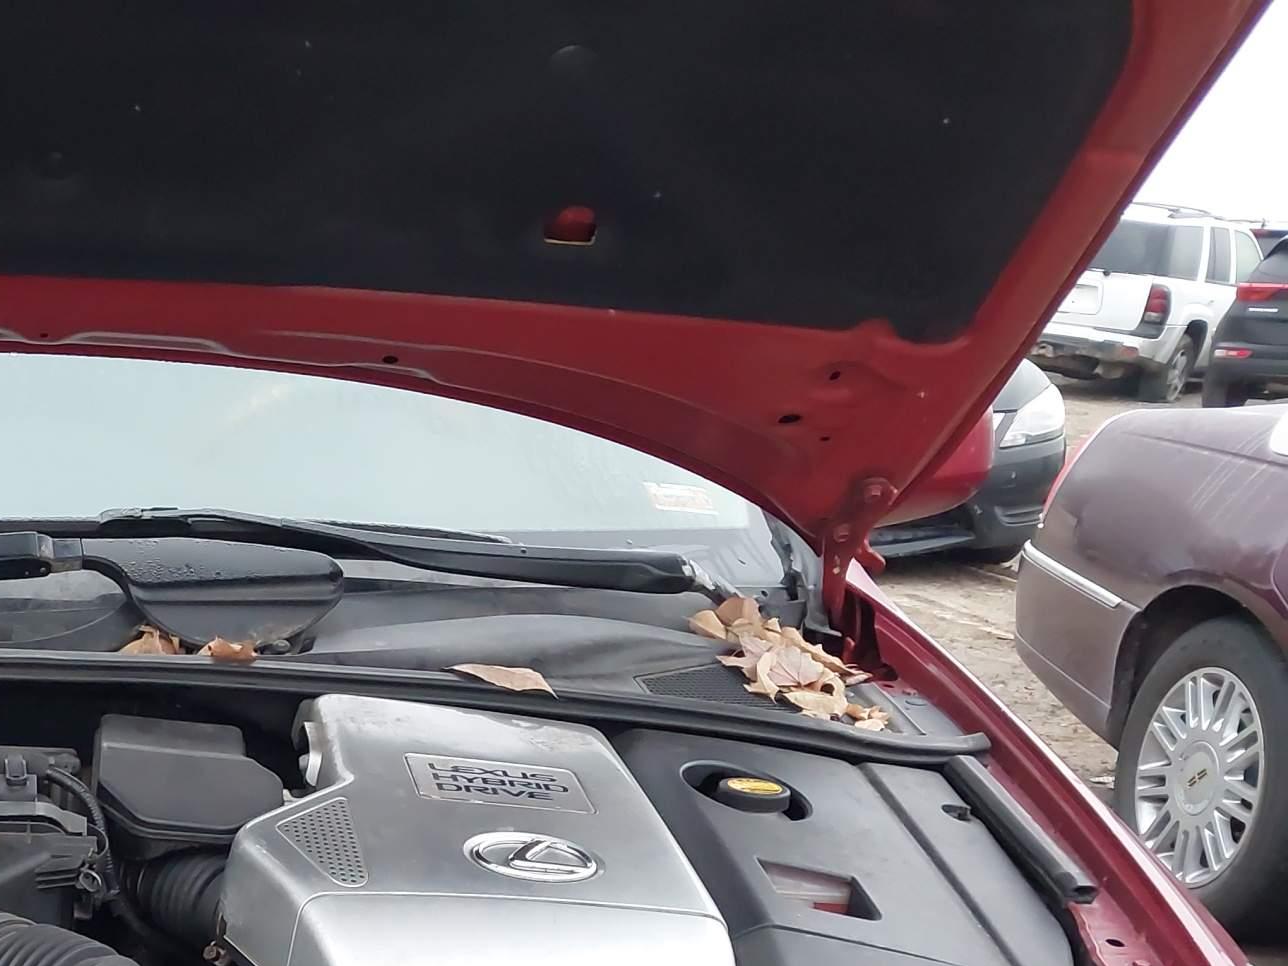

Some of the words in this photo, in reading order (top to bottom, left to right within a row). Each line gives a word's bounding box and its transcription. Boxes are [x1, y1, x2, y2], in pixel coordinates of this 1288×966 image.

[428, 763, 557, 782] LEXUS
[433, 773, 569, 793] HYBRID
[437, 783, 554, 801] DRIVE
